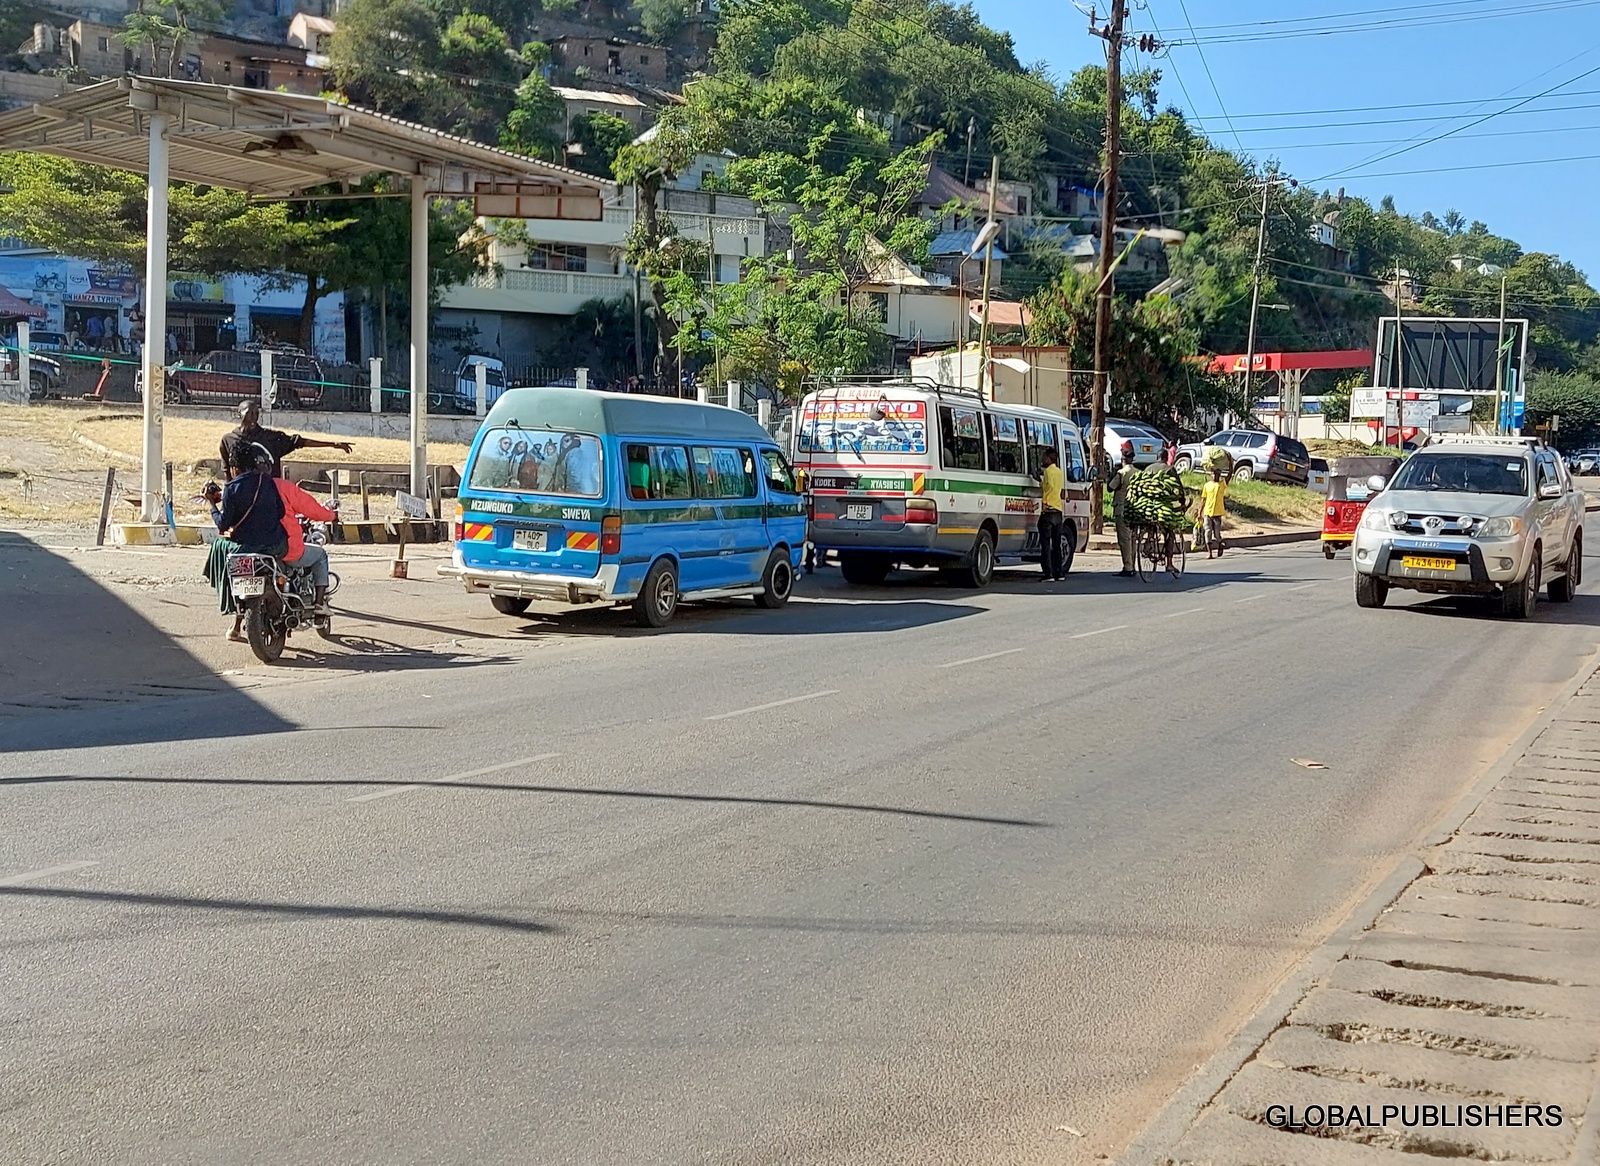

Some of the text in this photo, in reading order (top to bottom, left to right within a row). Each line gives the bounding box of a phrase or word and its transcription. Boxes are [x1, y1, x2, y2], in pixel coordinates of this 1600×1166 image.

[73, 293, 95, 301] HAMZA
[805, 402, 918, 413] KASHETO
[470, 499, 514, 514] MZUNGUKO
[562, 508, 591, 521] SWEYA
[1411, 557, 1452, 568] T434 DVP
